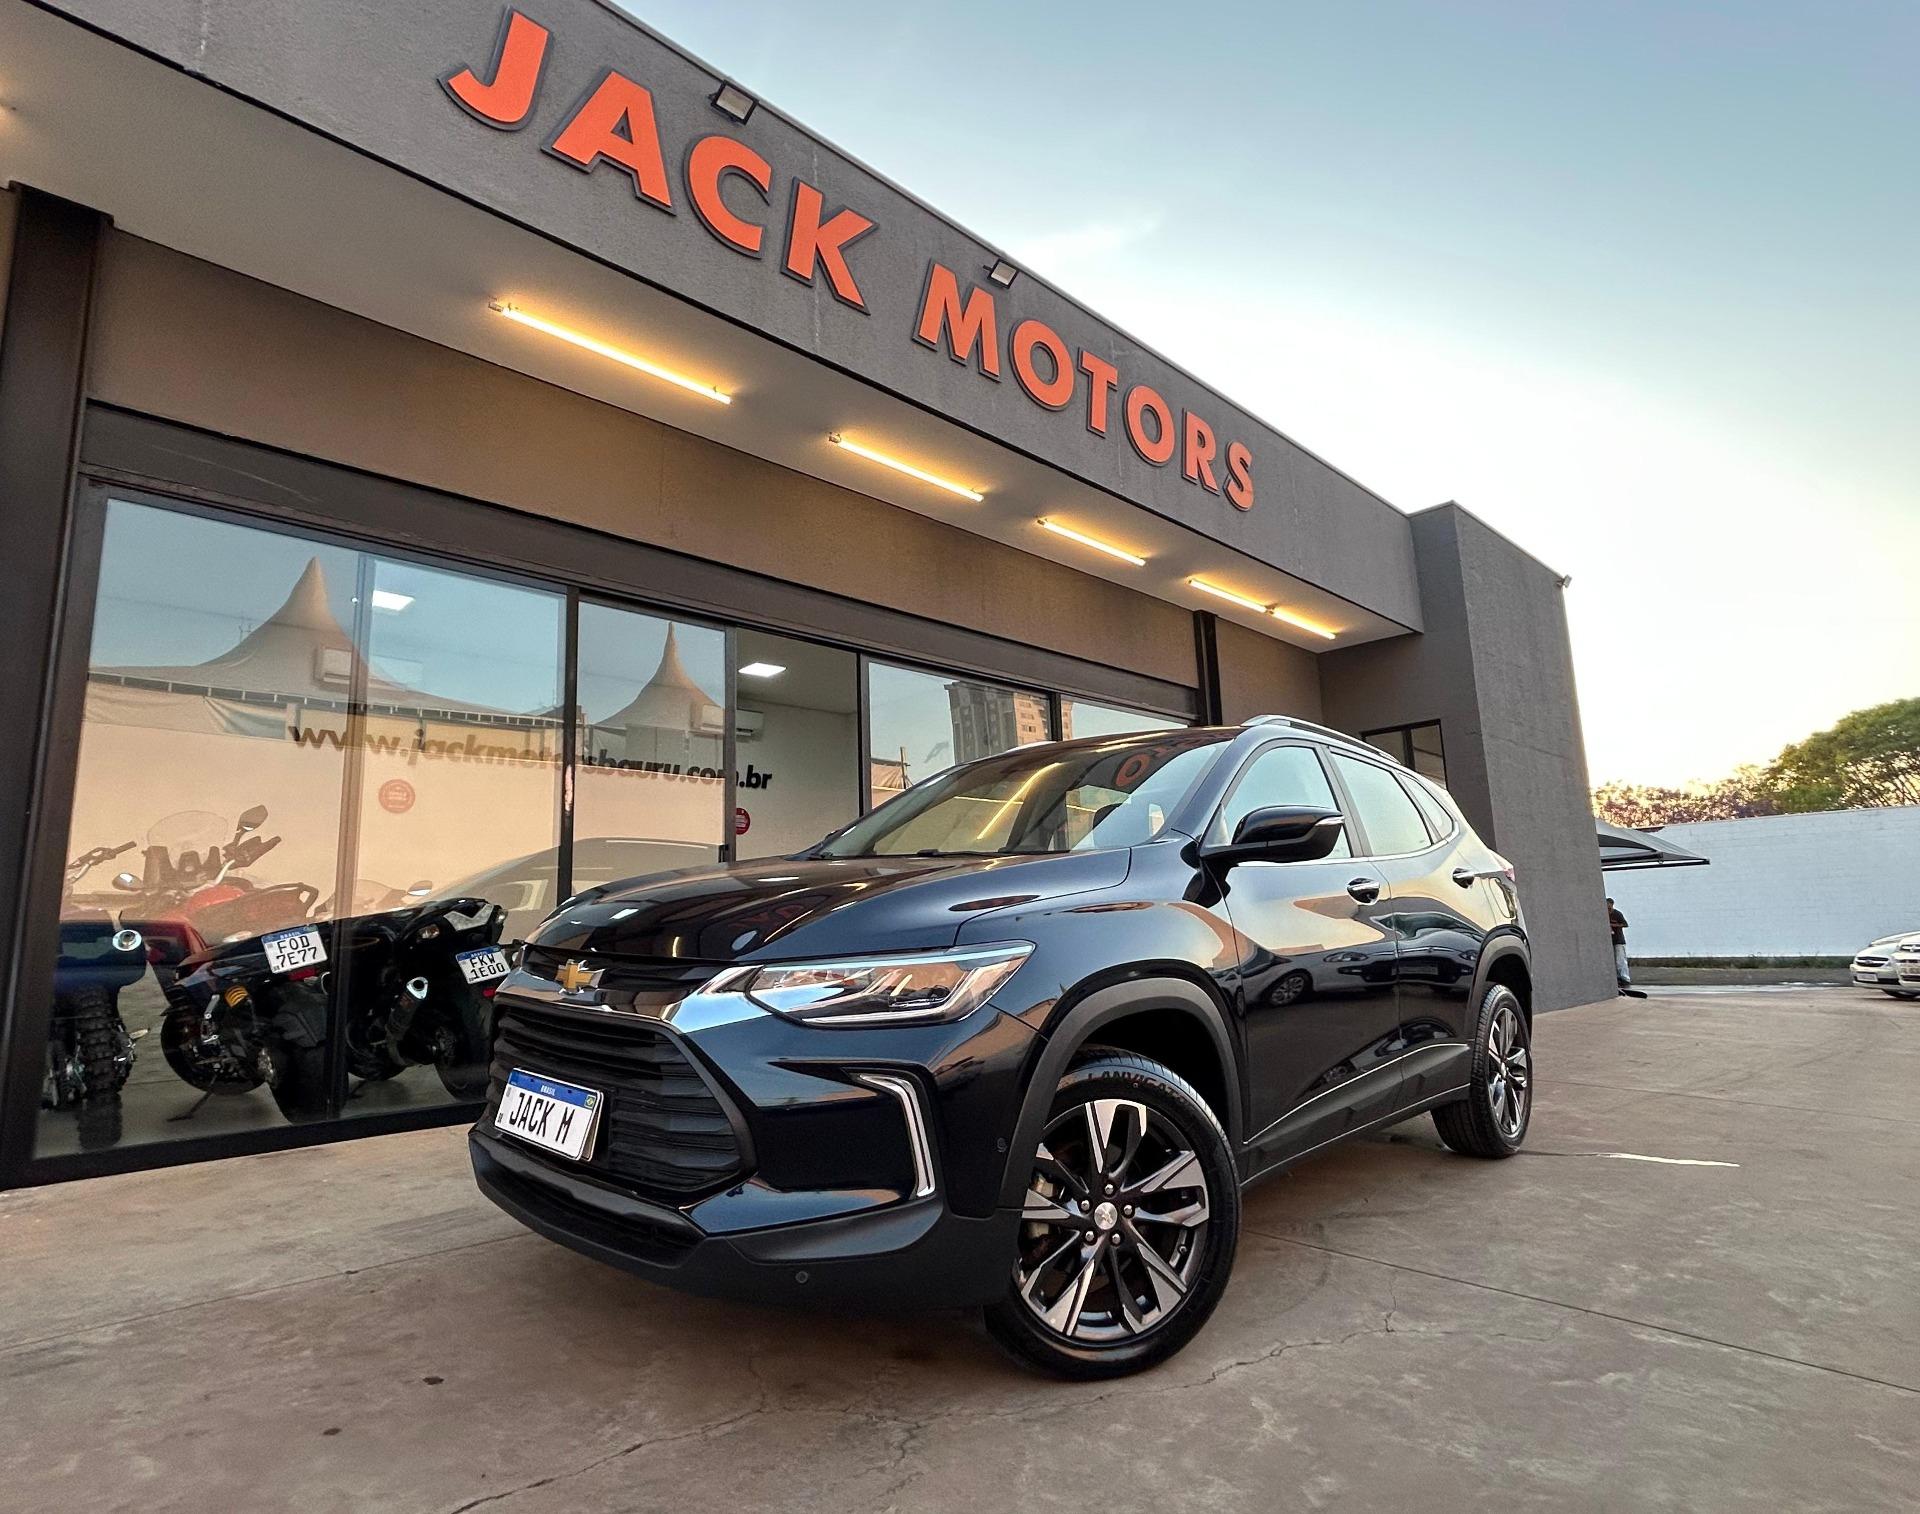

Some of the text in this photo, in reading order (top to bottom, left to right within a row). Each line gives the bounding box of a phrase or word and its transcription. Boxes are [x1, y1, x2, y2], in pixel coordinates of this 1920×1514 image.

[445, 10, 1256, 511] JACK MOTORS
[277, 935, 310, 954] FOD
[276, 946, 317, 968] 7E77
[470, 963, 506, 979] 1E00
[509, 1092, 576, 1145] JACK M
